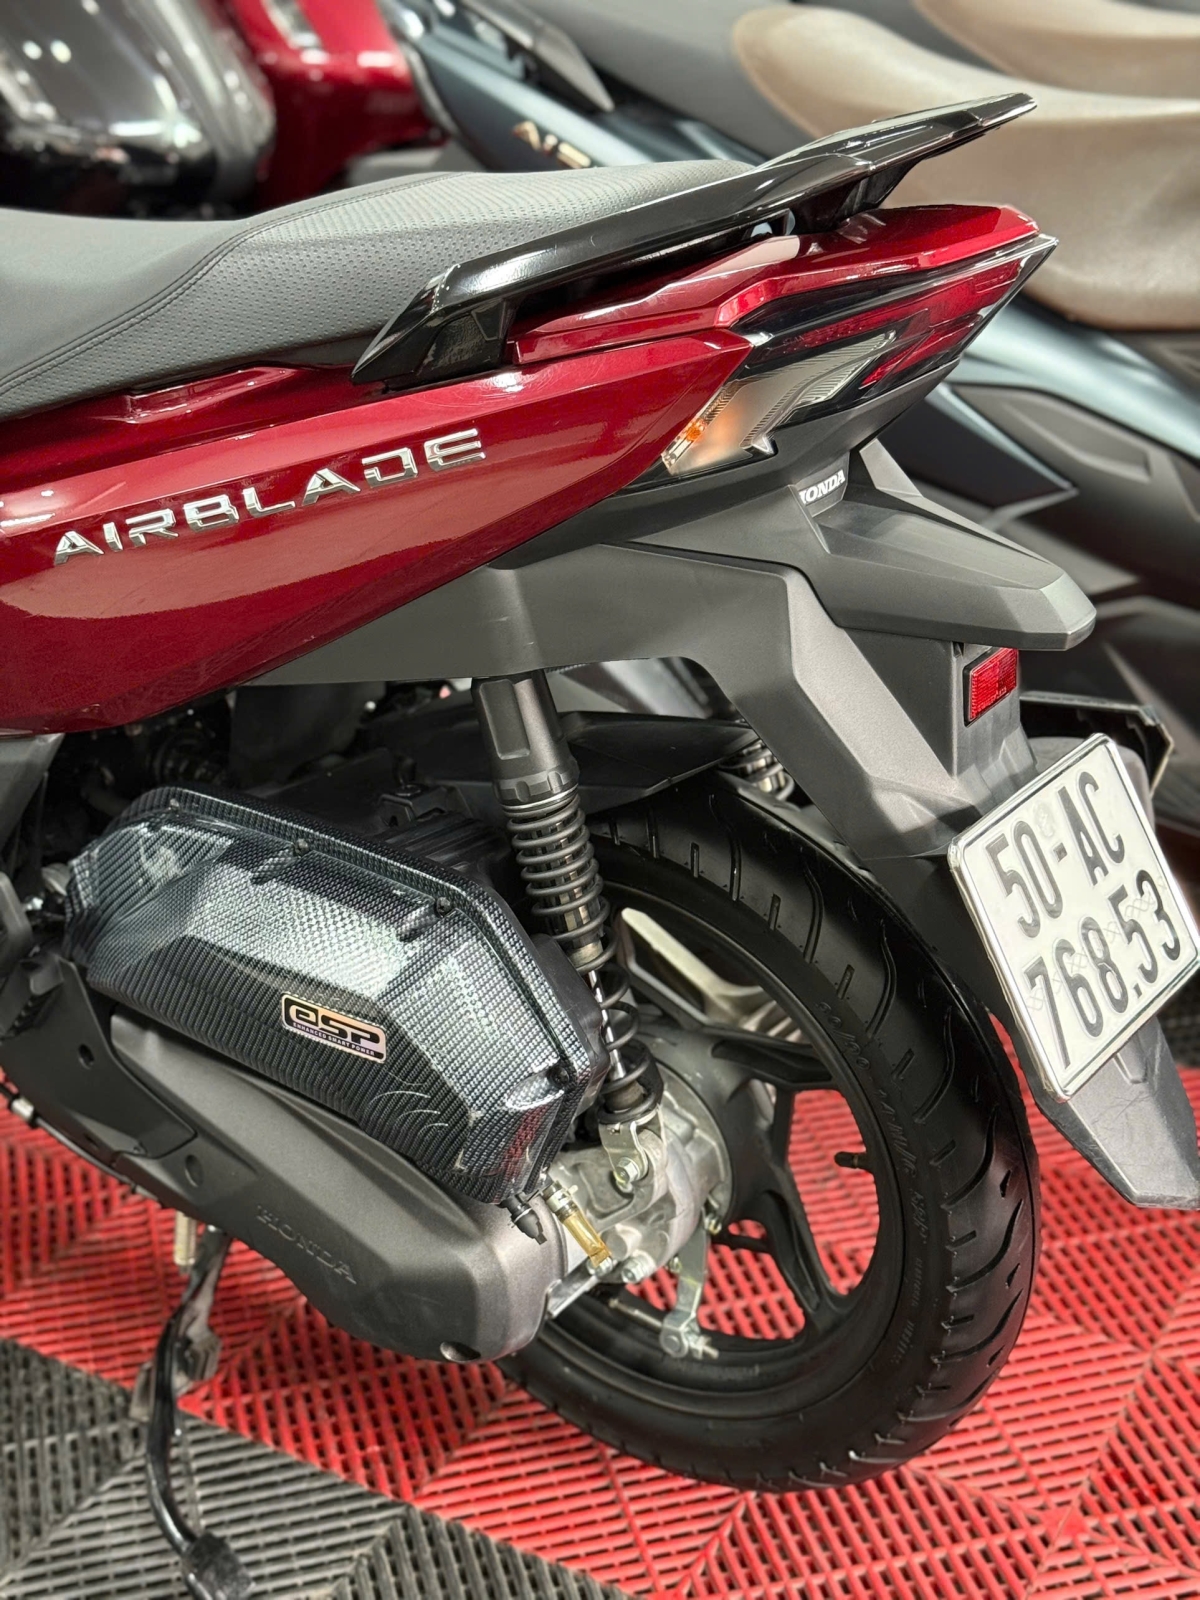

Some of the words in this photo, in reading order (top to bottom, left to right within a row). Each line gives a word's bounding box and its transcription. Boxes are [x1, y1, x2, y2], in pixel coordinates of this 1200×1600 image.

[54, 428, 486, 565] AIRBLADE
[984, 771, 1125, 939] 50-AC
[1023, 869, 1182, 1070] 768.53
[293, 1022, 327, 1039] ENHANCED
[328, 1035, 351, 1048] SMART
[351, 1043, 375, 1056] POWER
[256, 1205, 357, 1285] HONDA
